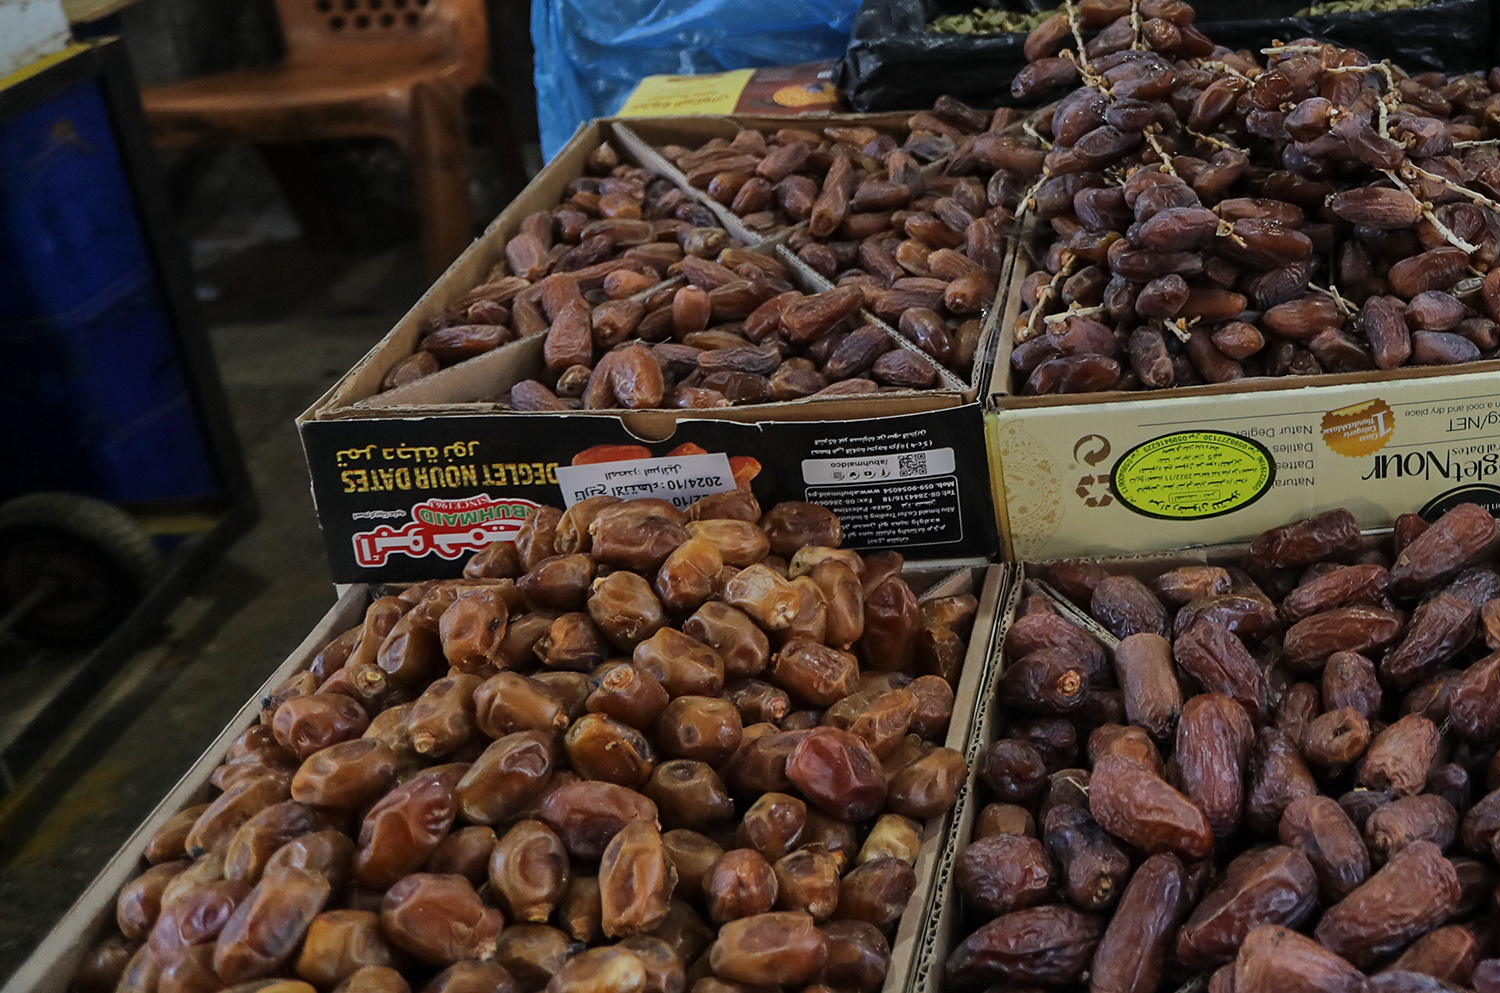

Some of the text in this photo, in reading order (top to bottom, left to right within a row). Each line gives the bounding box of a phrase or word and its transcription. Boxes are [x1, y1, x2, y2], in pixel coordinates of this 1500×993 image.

[1404, 407, 1429, 418] place
[1430, 405, 1445, 417] dry
[1447, 405, 1464, 415] and
[1466, 403, 1485, 413] cool
[1320, 417, 1375, 436] Handelsklasse
[1370, 410, 1392, 438] 1
[1279, 424, 1313, 437] Natur
[1358, 433, 1379, 443] Class
[336, 440, 480, 466] تمر دجلة نور
[1272, 441, 1314, 454] Datiles
[1451, 444, 1484, 457] Dates
[644, 464, 681, 476] اسرائيل
[830, 459, 888, 469] /abuhmaidco
[1275, 459, 1315, 471] Dattes
[1361, 449, 1450, 481] Nour
[340, 462, 560, 493] DEGLET NOUR DATES
[1271, 476, 1315, 489] Natural
[574, 485, 607, 501] تاريخ
[667, 476, 722, 488] 2024/10
[808, 488, 880, 498] www.abuhmaid.ps
[883, 480, 955, 494] Mob. 059-9054054
[882, 491, 940, 502] 08-2844316/18
[870, 512, 896, 520] Trading
[942, 506, 955, 514] Abu
[357, 520, 518, 565] أبو حمي
